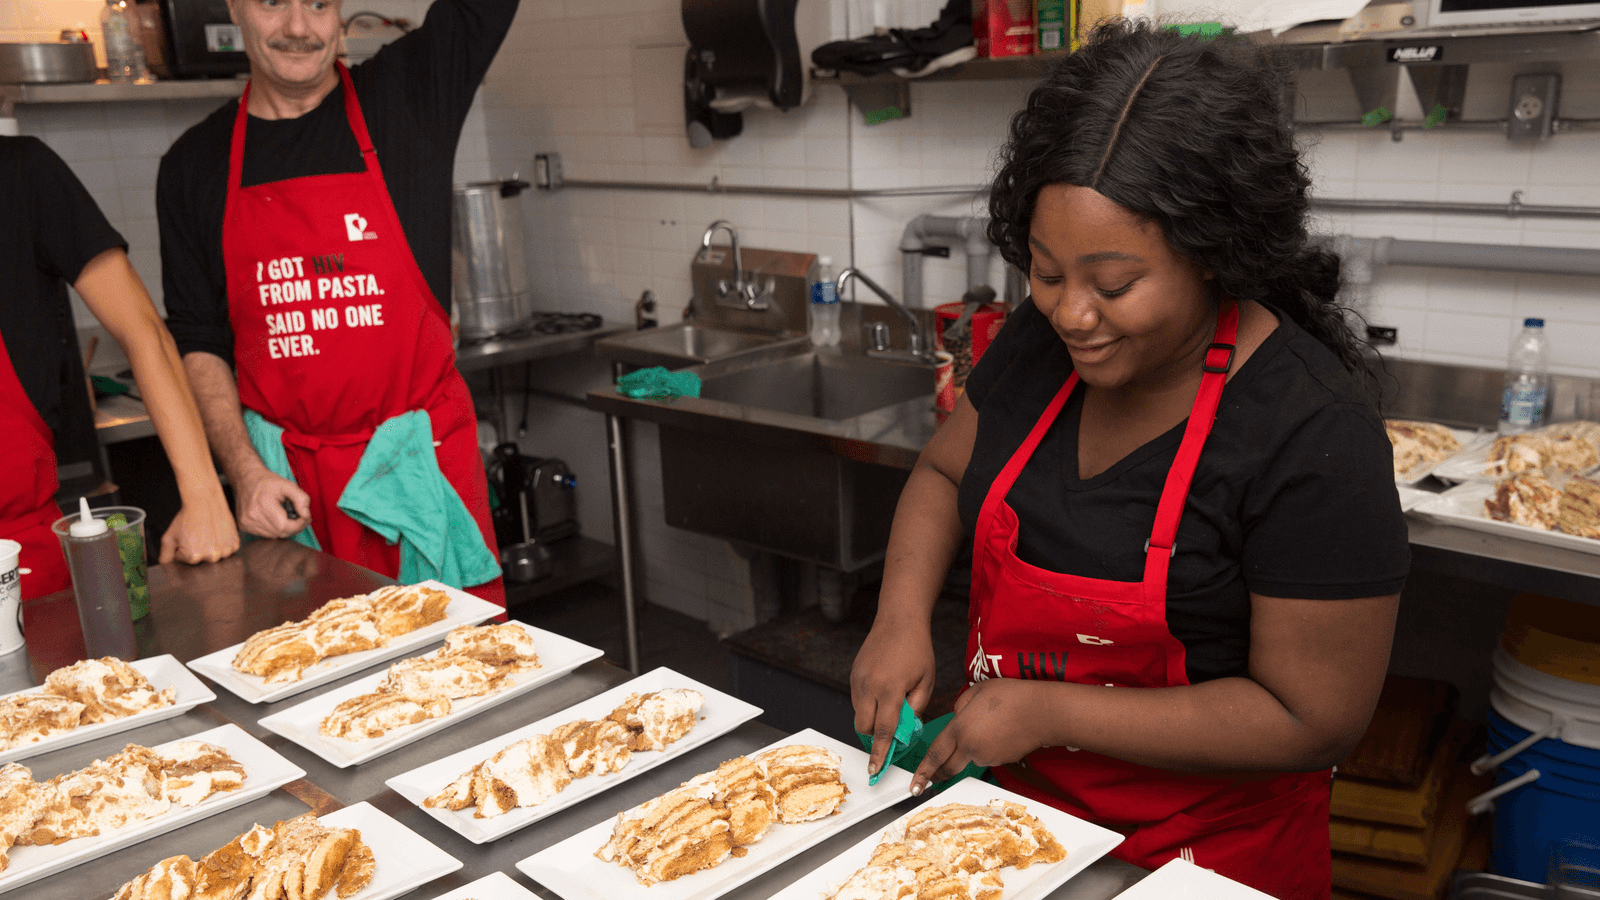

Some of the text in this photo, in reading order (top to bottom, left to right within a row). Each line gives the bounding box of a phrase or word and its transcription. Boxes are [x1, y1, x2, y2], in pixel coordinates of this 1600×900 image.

[256, 253, 344, 282] I GOT HIV
[258, 273, 385, 306] FROM PASTA.
[265, 304, 384, 335] SAID NO ONE
[268, 334, 320, 359] EVER.
[1017, 652, 1069, 682] HIV
